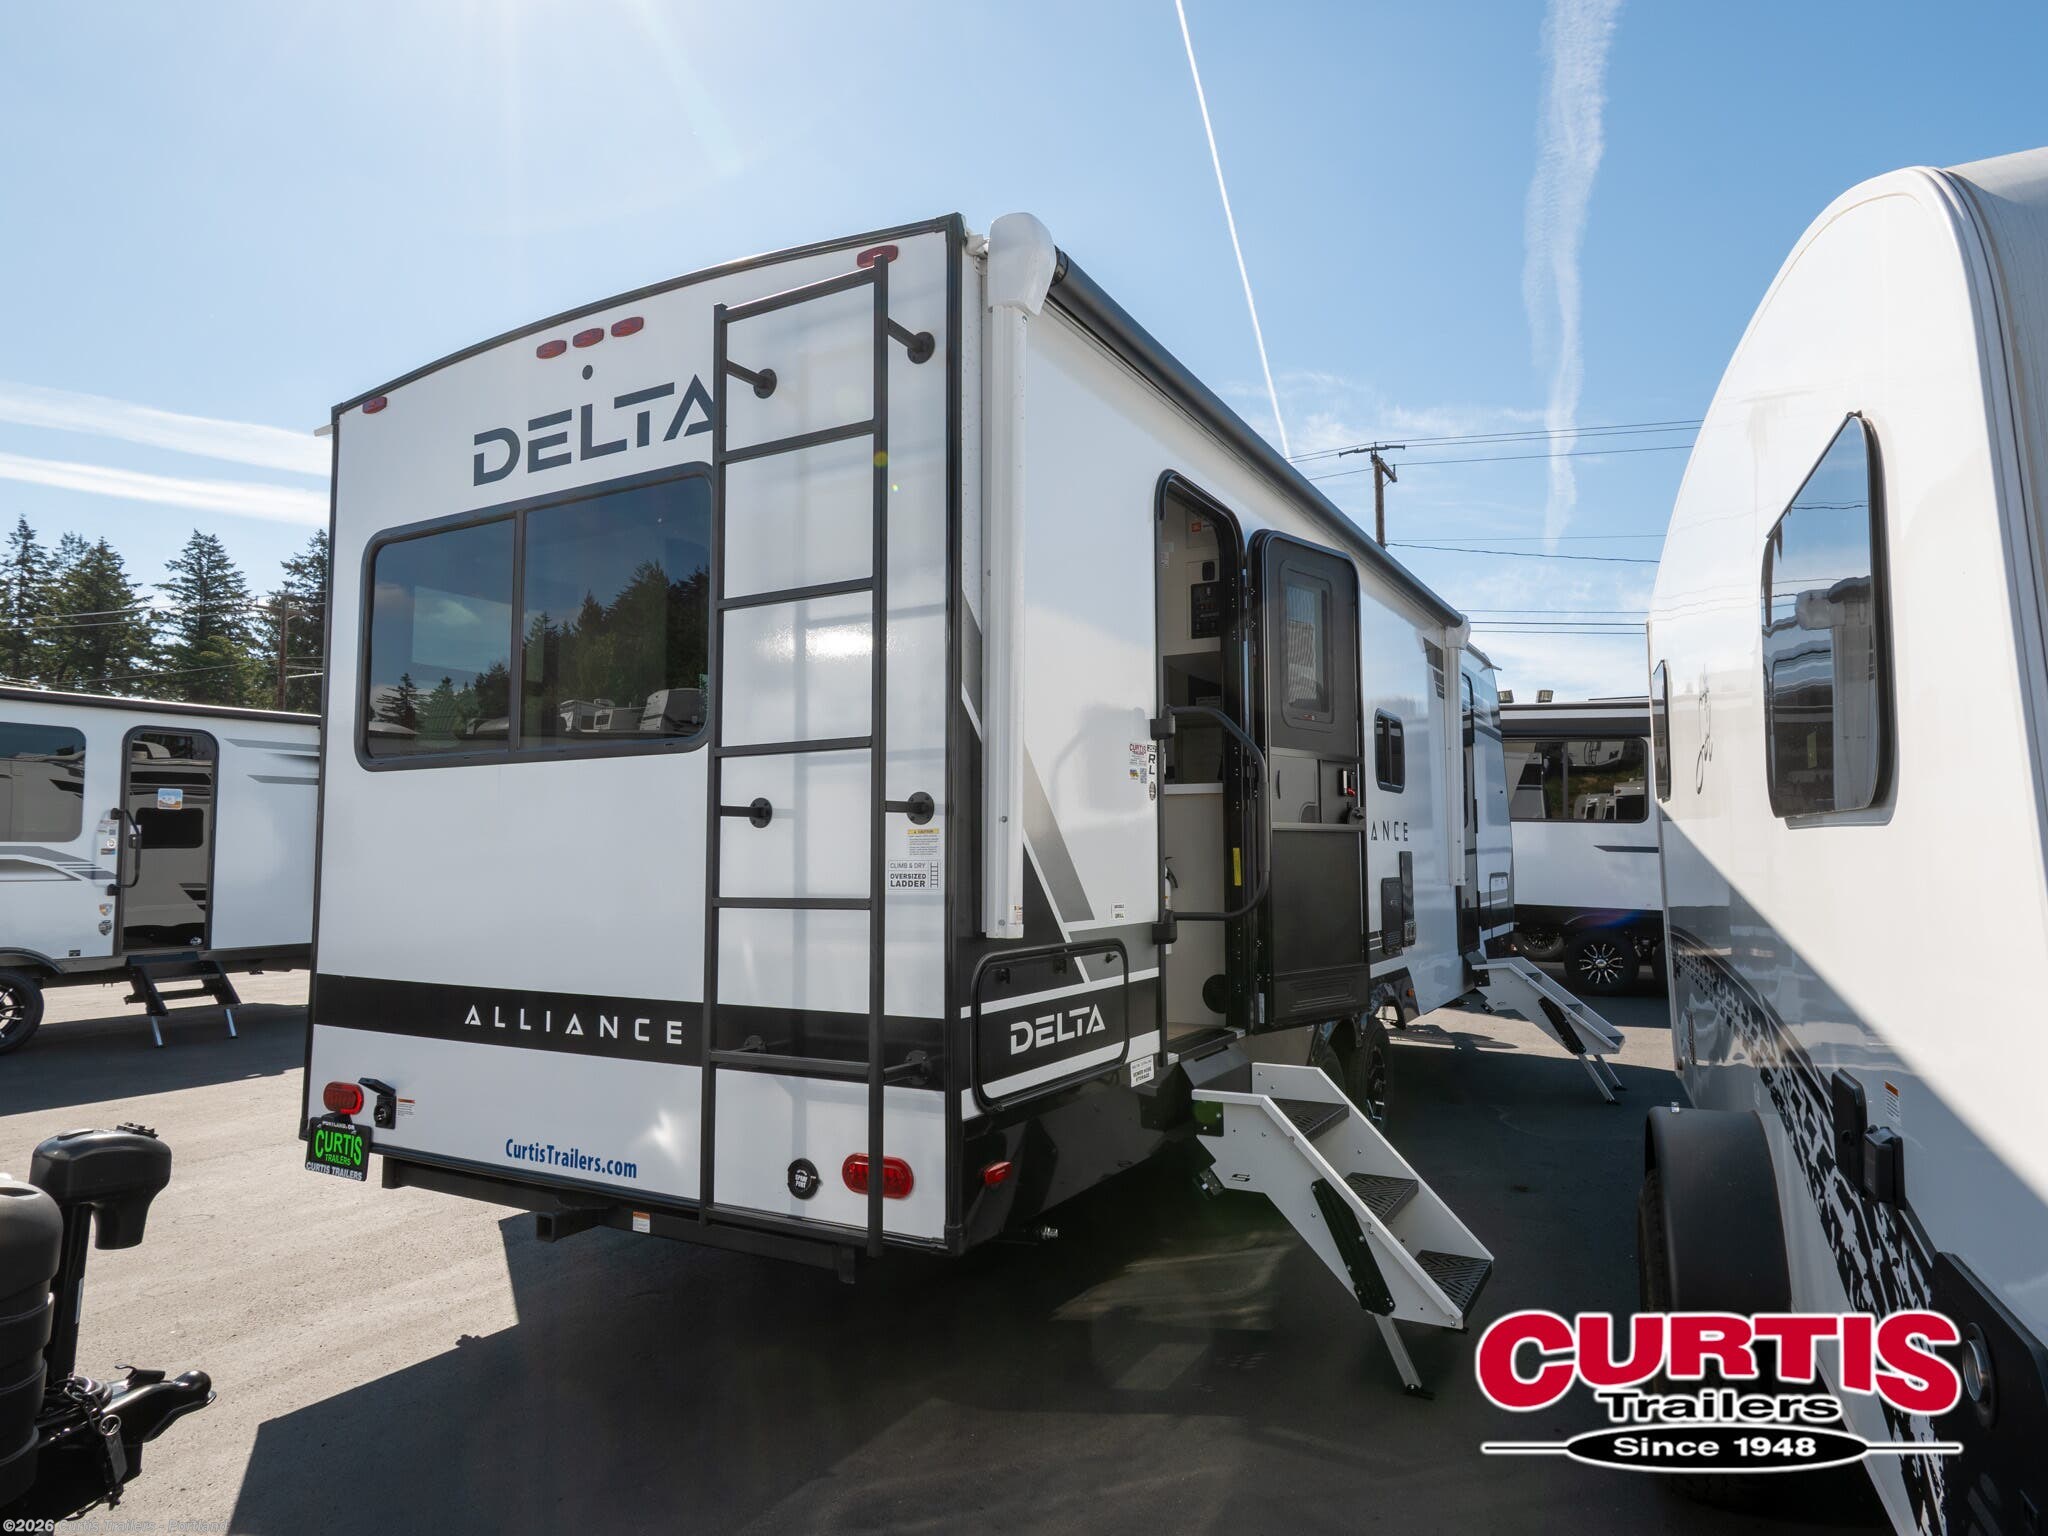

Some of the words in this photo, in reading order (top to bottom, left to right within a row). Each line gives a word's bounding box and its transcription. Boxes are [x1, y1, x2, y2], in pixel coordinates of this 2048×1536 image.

[473, 373, 714, 487] DELTA
[890, 880, 925, 888] LADDER
[464, 1004, 684, 1046] ALLIANCE
[1009, 1003, 1106, 1056] DELTA
[315, 1129, 363, 1166] CURTIS
[325, 1153, 351, 1166] TRAILERS
[505, 1138, 638, 1180] CurtisTrailers.com
[306, 1161, 331, 1174] CURTIS
[331, 1165, 363, 1181] TRAILERS
